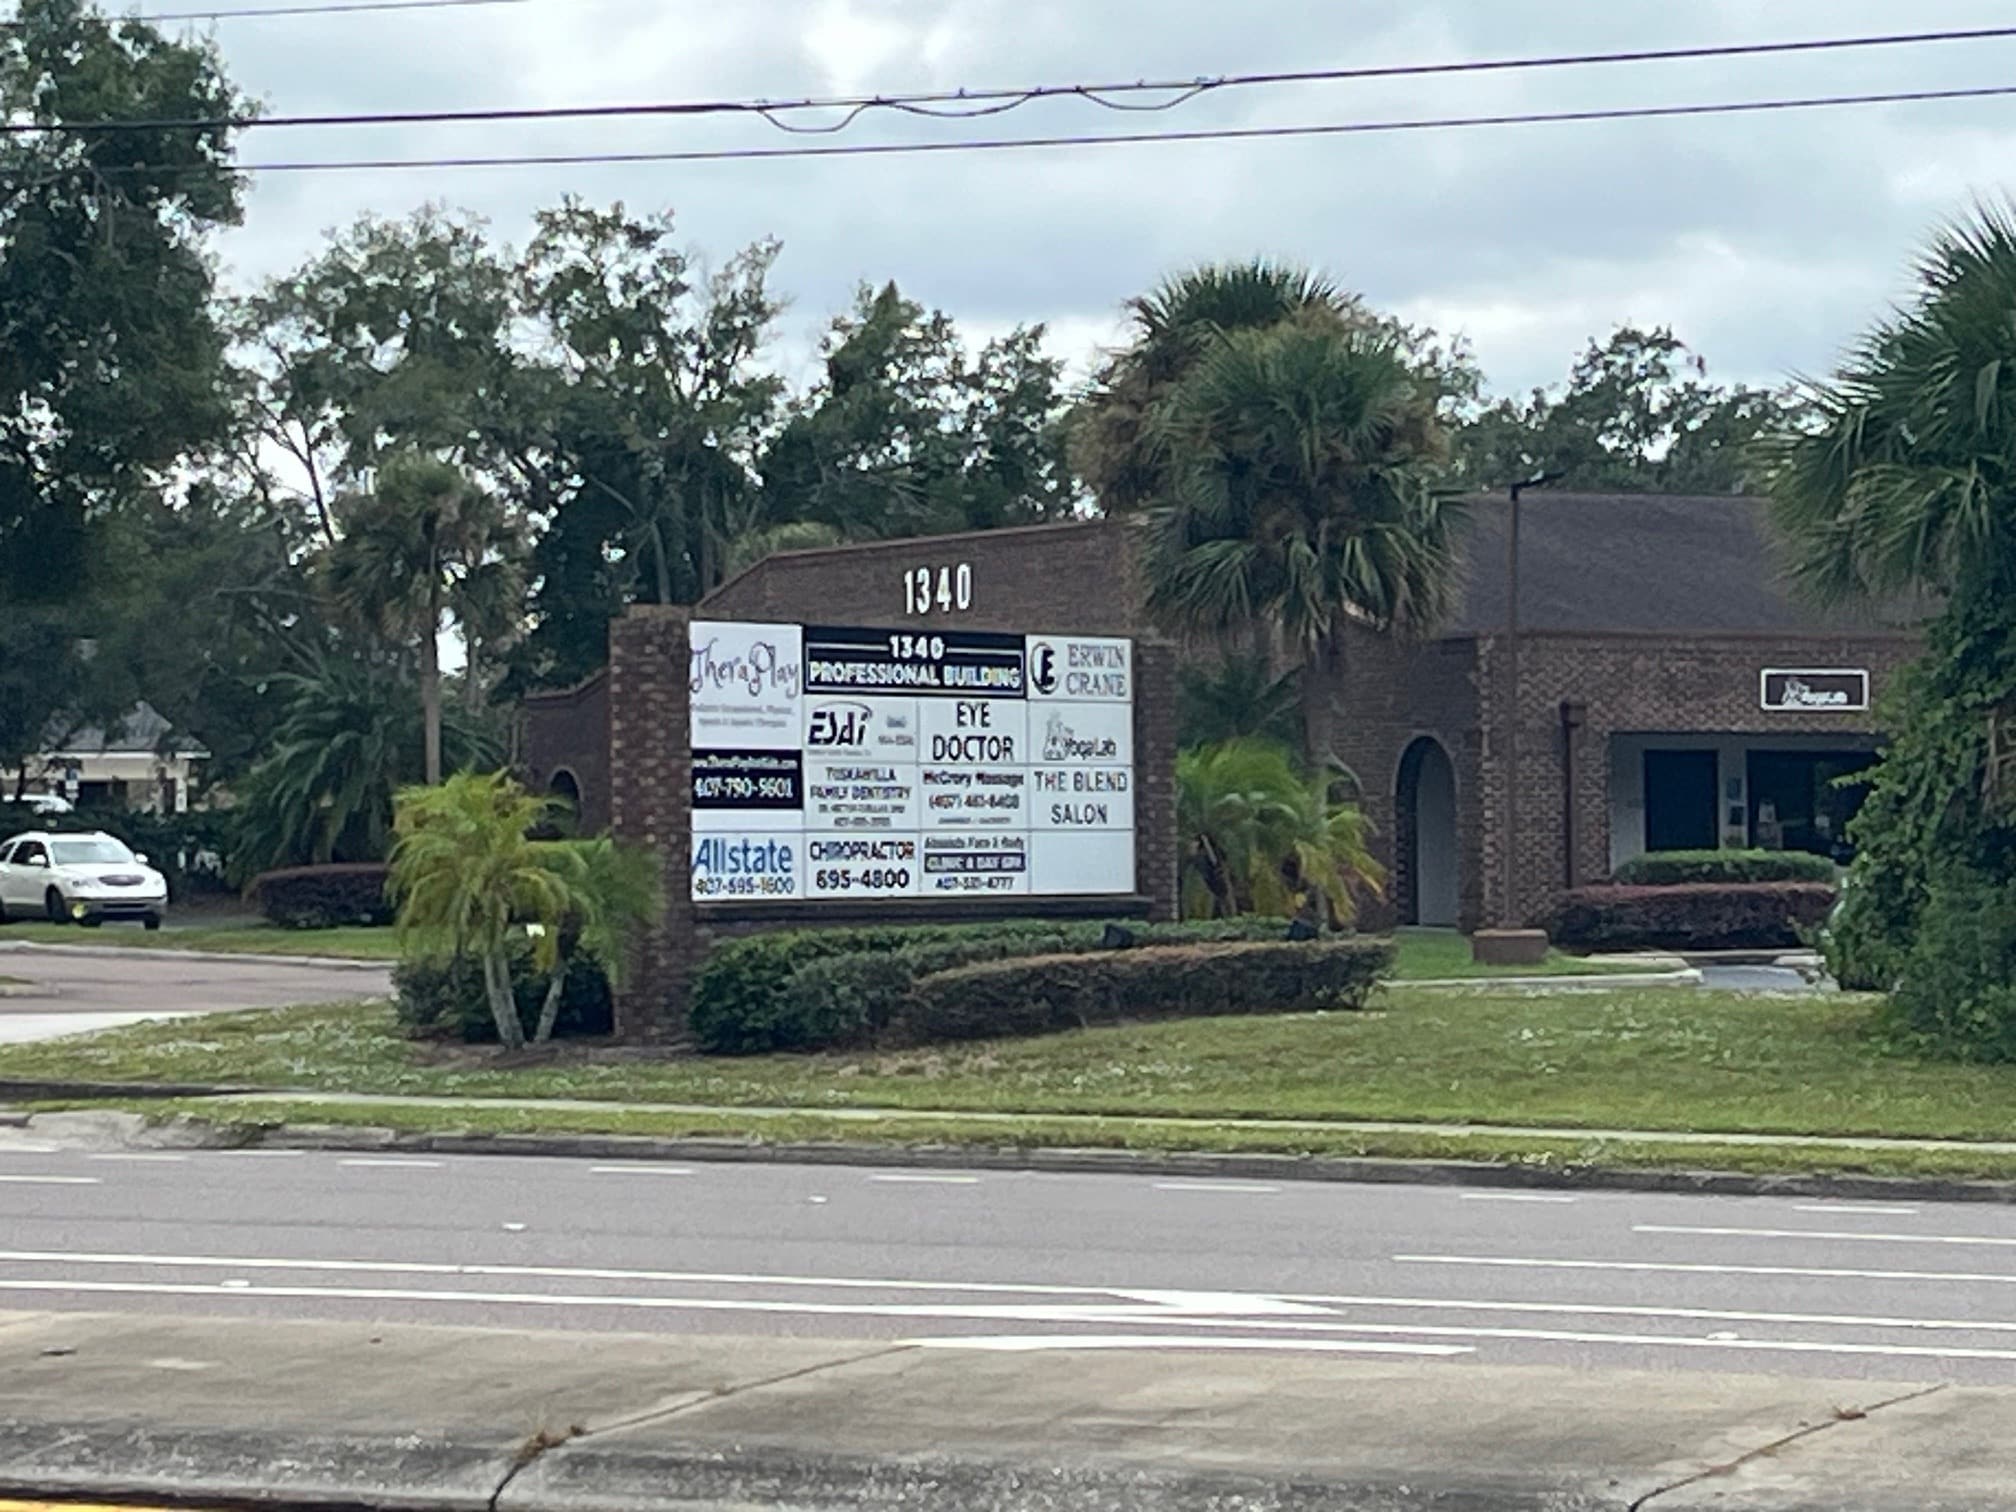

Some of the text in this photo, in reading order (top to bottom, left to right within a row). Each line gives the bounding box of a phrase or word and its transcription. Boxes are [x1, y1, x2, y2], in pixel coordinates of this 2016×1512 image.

[904, 563, 971, 614] 1340
[889, 635, 945, 659] 1340
[1067, 644, 1126, 667] ERWIN
[808, 661, 1021, 688] PROFESSIONAL BUILDING
[1066, 671, 1127, 697] CRANE
[956, 701, 990, 728] EYE
[932, 735, 1014, 761] DOCTOR
[1034, 771, 1128, 793] THE BLEND
[1051, 803, 1108, 824] SALON
[693, 839, 793, 875] Allstate
[809, 841, 915, 860] CHIROPRACTOR
[816, 868, 910, 889] 695-4800
